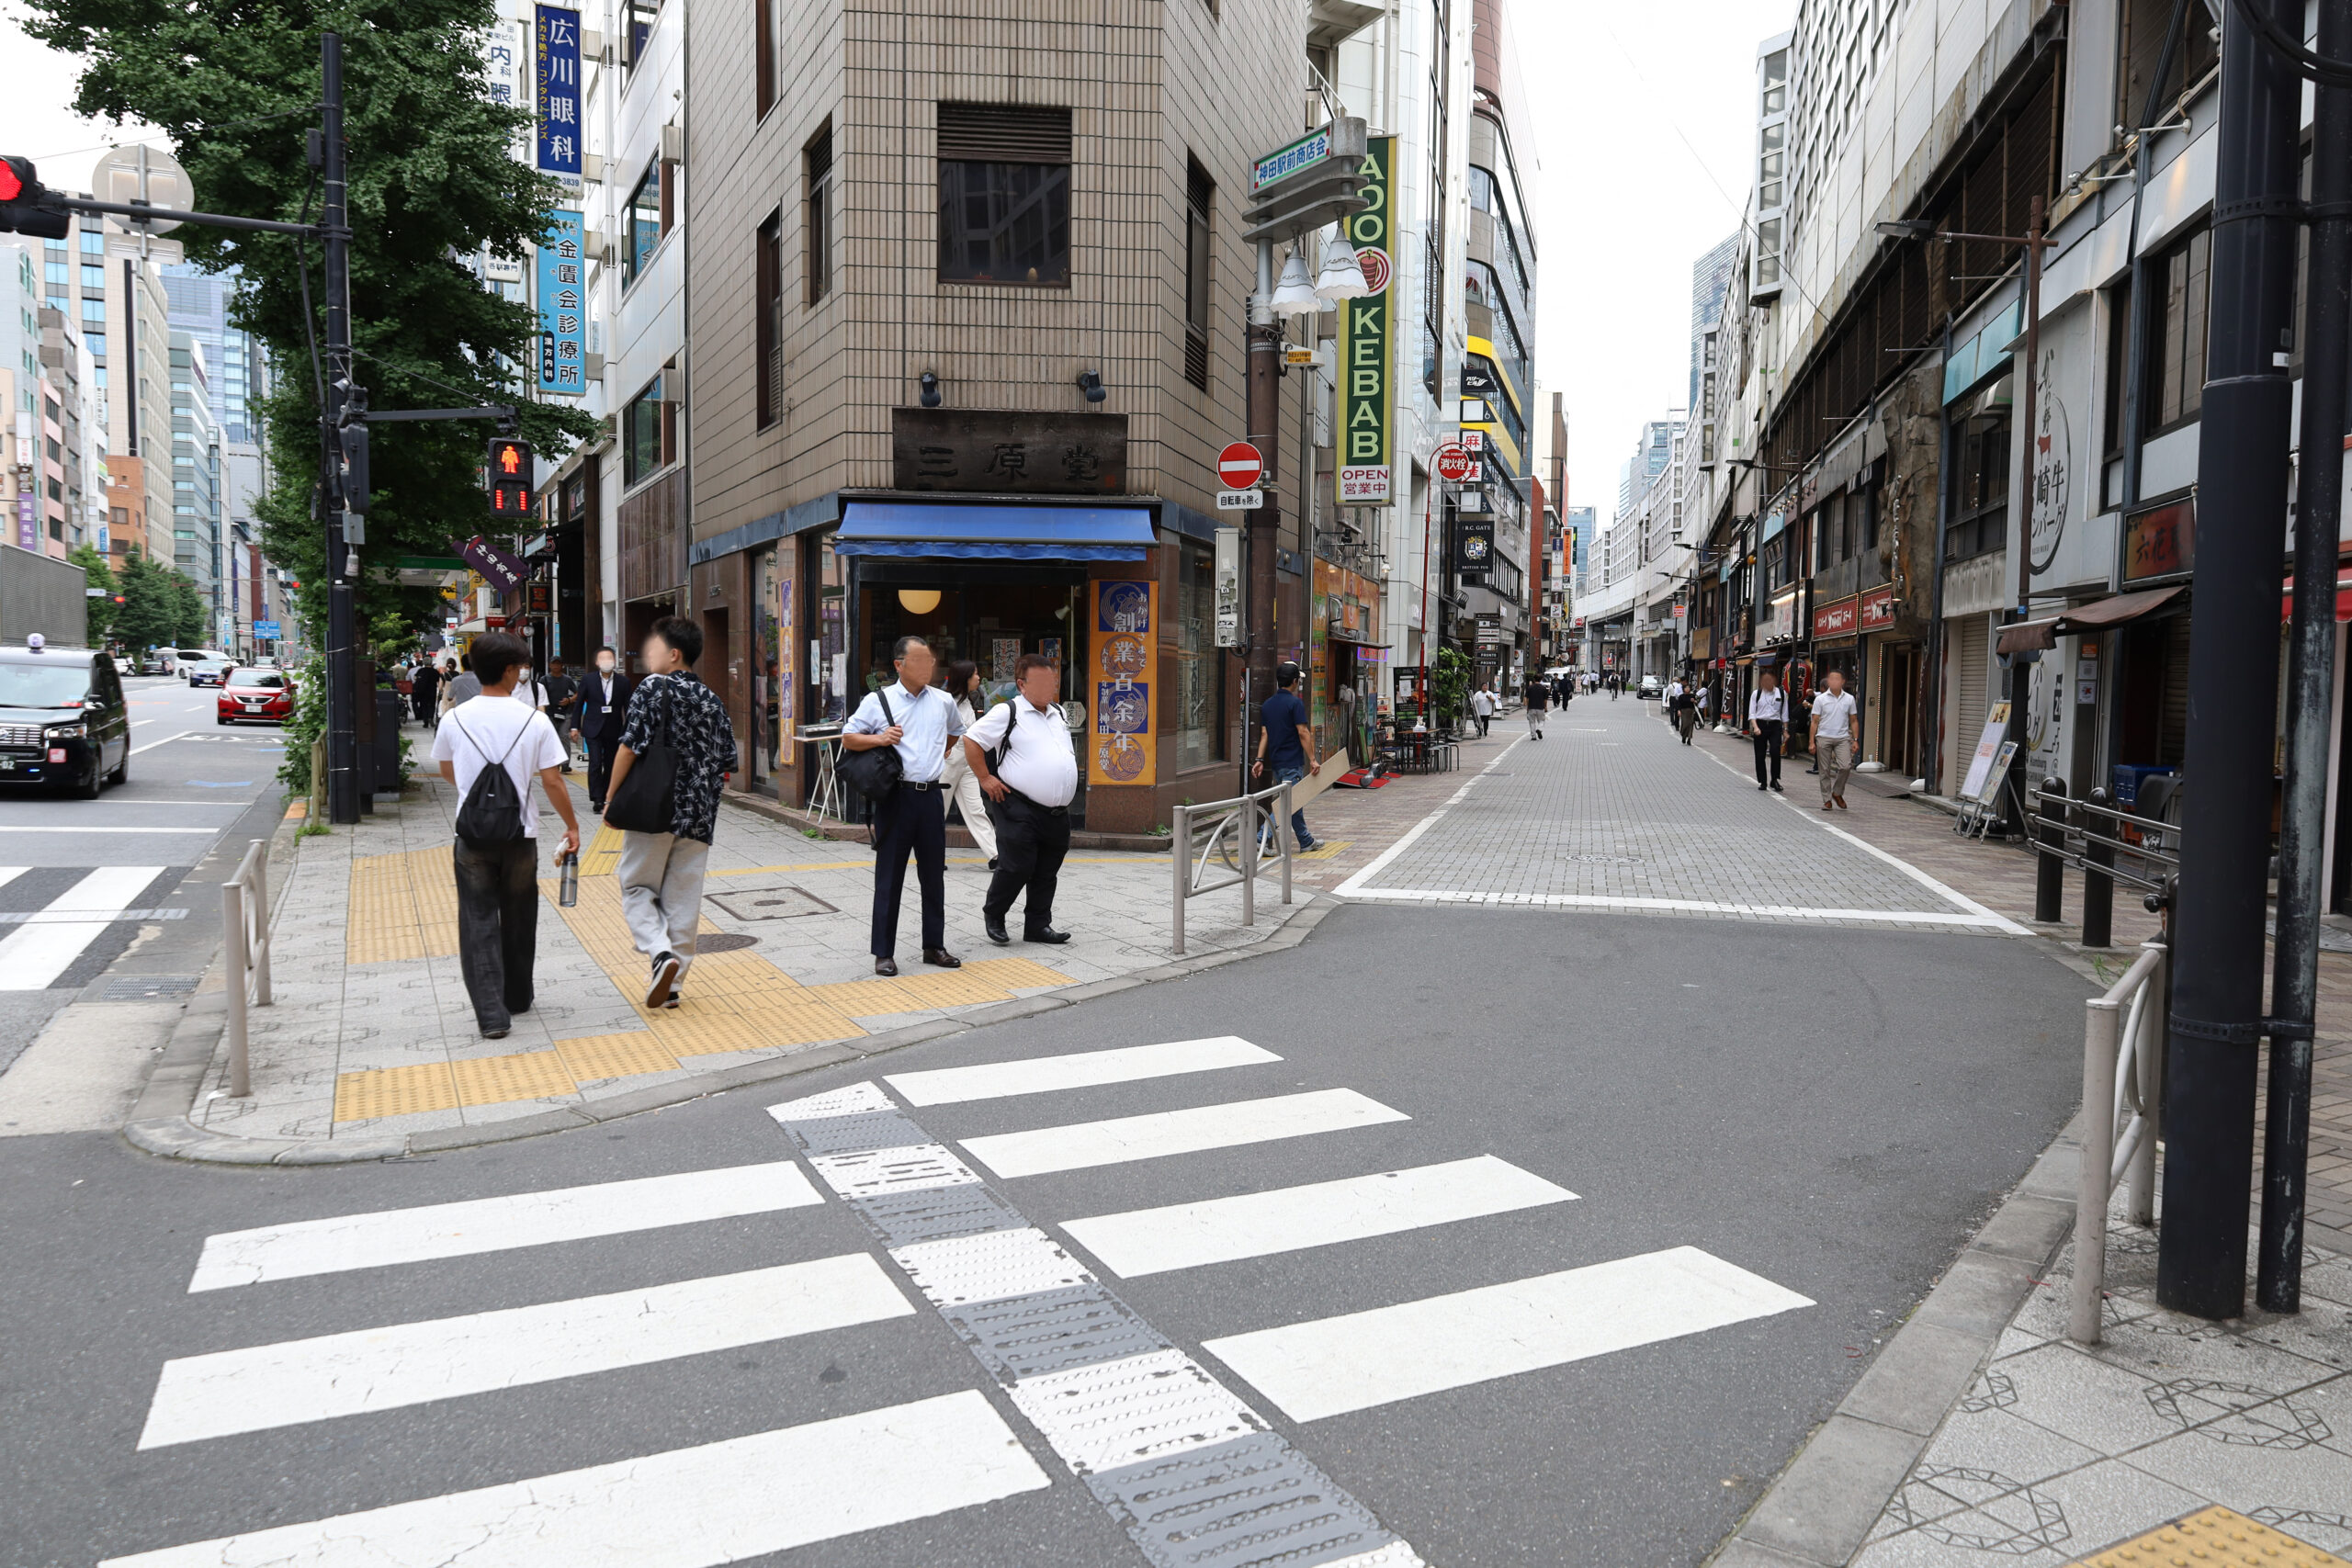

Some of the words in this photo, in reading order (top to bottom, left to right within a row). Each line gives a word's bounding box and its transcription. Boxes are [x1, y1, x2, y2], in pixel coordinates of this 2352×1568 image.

[550, 18, 575, 164] 広川眼科
[1259, 136, 1327, 182] 神田駅前商店会
[1353, 152, 1385, 243] ADO
[559, 239, 579, 385] 金匱会診療所
[544, 336, 553, 378] 漢方内科
[1350, 307, 1382, 458] KEBAB
[1484, 411, 1491, 419] 6
[918, 443, 1100, 481] 三原堂
[1464, 434, 1480, 448] 麻
[1484, 442, 1489, 450] 5
[1341, 469, 1388, 480] OPEN
[1440, 457, 1465, 470] 消火栓
[2032, 460, 2064, 508] 崎牛
[1220, 495, 1259, 506] 自転車を除く
[1344, 482, 1386, 495] 営業中
[1482, 502, 1487, 511] 3
[1137, 592, 1148, 669] おかげさまで
[1359, 647, 1385, 660] OPEN
[1114, 611, 1136, 752] 創業百余年
[1722, 671, 1736, 713] 牛たん
[1099, 713, 1109, 771] 神田三原堂
